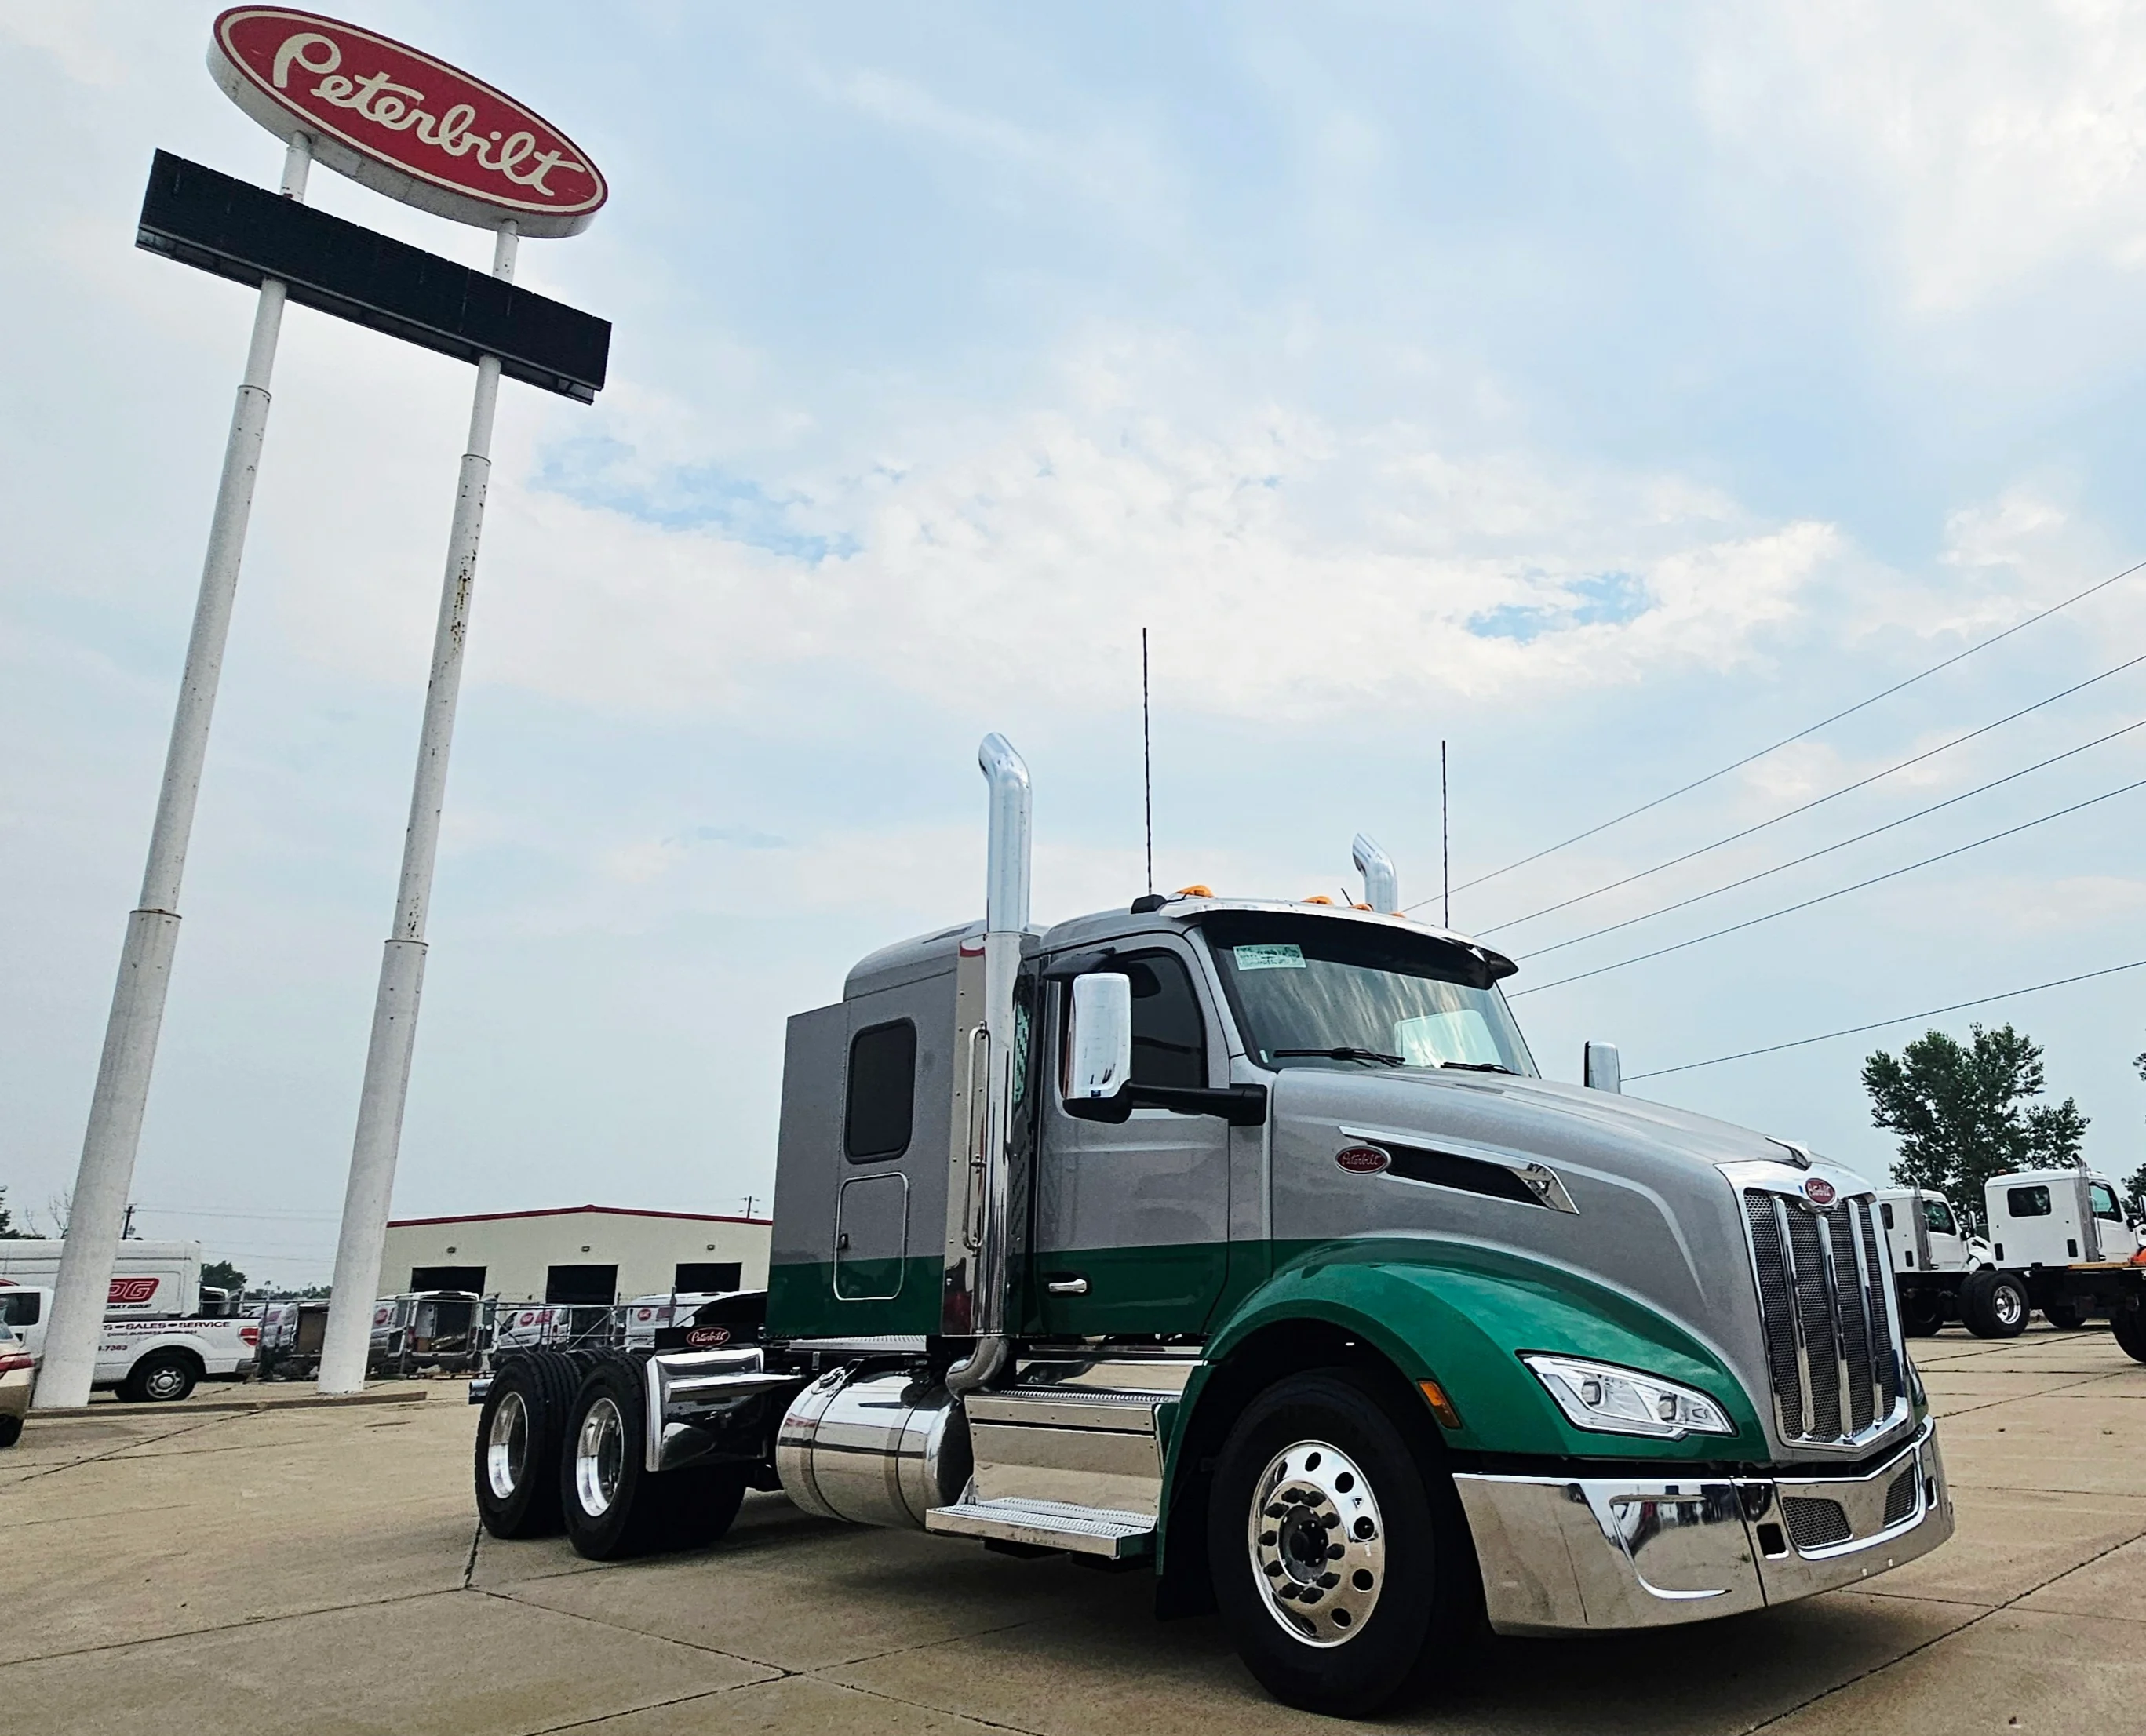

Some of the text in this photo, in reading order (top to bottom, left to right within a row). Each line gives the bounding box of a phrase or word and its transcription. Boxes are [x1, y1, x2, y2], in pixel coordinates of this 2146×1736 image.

[272, 32, 585, 197] Peterbilt
[1341, 1152, 1382, 1166] Peterbilt
[691, 1331, 728, 1343] Peterbilt
